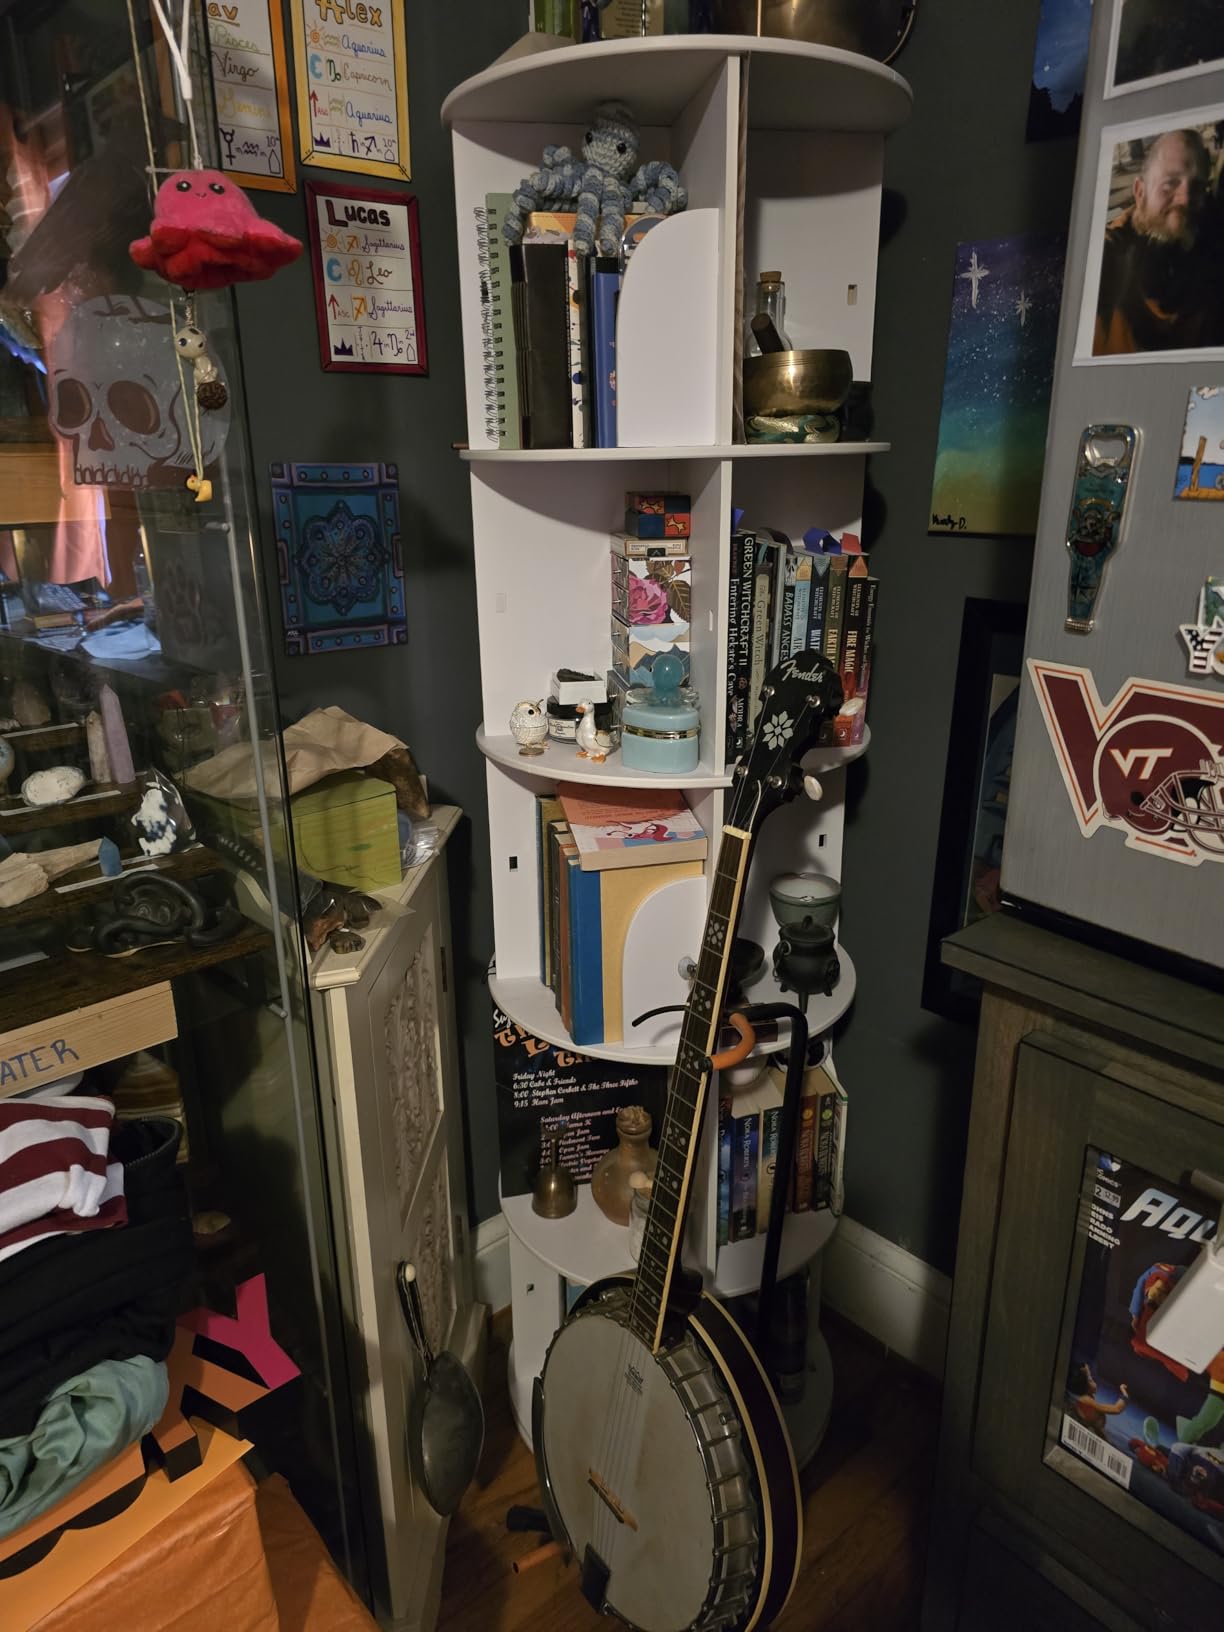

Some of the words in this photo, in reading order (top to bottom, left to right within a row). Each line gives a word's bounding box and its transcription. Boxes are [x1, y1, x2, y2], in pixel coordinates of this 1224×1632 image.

[206, 3, 239, 21] av
[316, 0, 383, 27] Alex
[342, 34, 388, 58] Aquarius
[210, 50, 259, 82] Virgo
[343, 62, 392, 92] Capricorn
[346, 101, 393, 127] Aquarius
[325, 199, 391, 228] Lucas
[361, 234, 405, 254] Sagittarius
[367, 261, 393, 285] Leo
[368, 295, 413, 321] Sagittarius
[742, 537, 754, 578] GREEN
[728, 578, 740, 625] Entering
[783, 592, 794, 627] BADASS
[739, 581, 753, 656] WITCHCRAFT
[755, 600, 766, 632] Green
[728, 627, 738, 670] Hekate's
[754, 634, 764, 666] Witch
[780, 629, 791, 660] ANCES
[826, 629, 839, 654] EARTH
[846, 630, 858, 648] FIRE
[780, 660, 823, 683] Fender
[844, 649, 856, 673] MAGIC
[727, 673, 737, 696] Cave
[1108, 748, 1173, 780] VT
[0, 1039, 80, 1086] ATER
[512, 1071, 535, 1082] Friday
[536, 1069, 555, 1079] Night
[513, 1081, 529, 1089] 6:30
[553, 1076, 577, 1085] Friends
[531, 1087, 557, 1098] Stephen
[588, 1082, 600, 1091] The
[513, 1100, 529, 1108] 9:15
[540, 1114, 570, 1123] Saturday
[744, 1117, 752, 1139] NORA
[743, 1140, 751, 1168] ROBERTS
